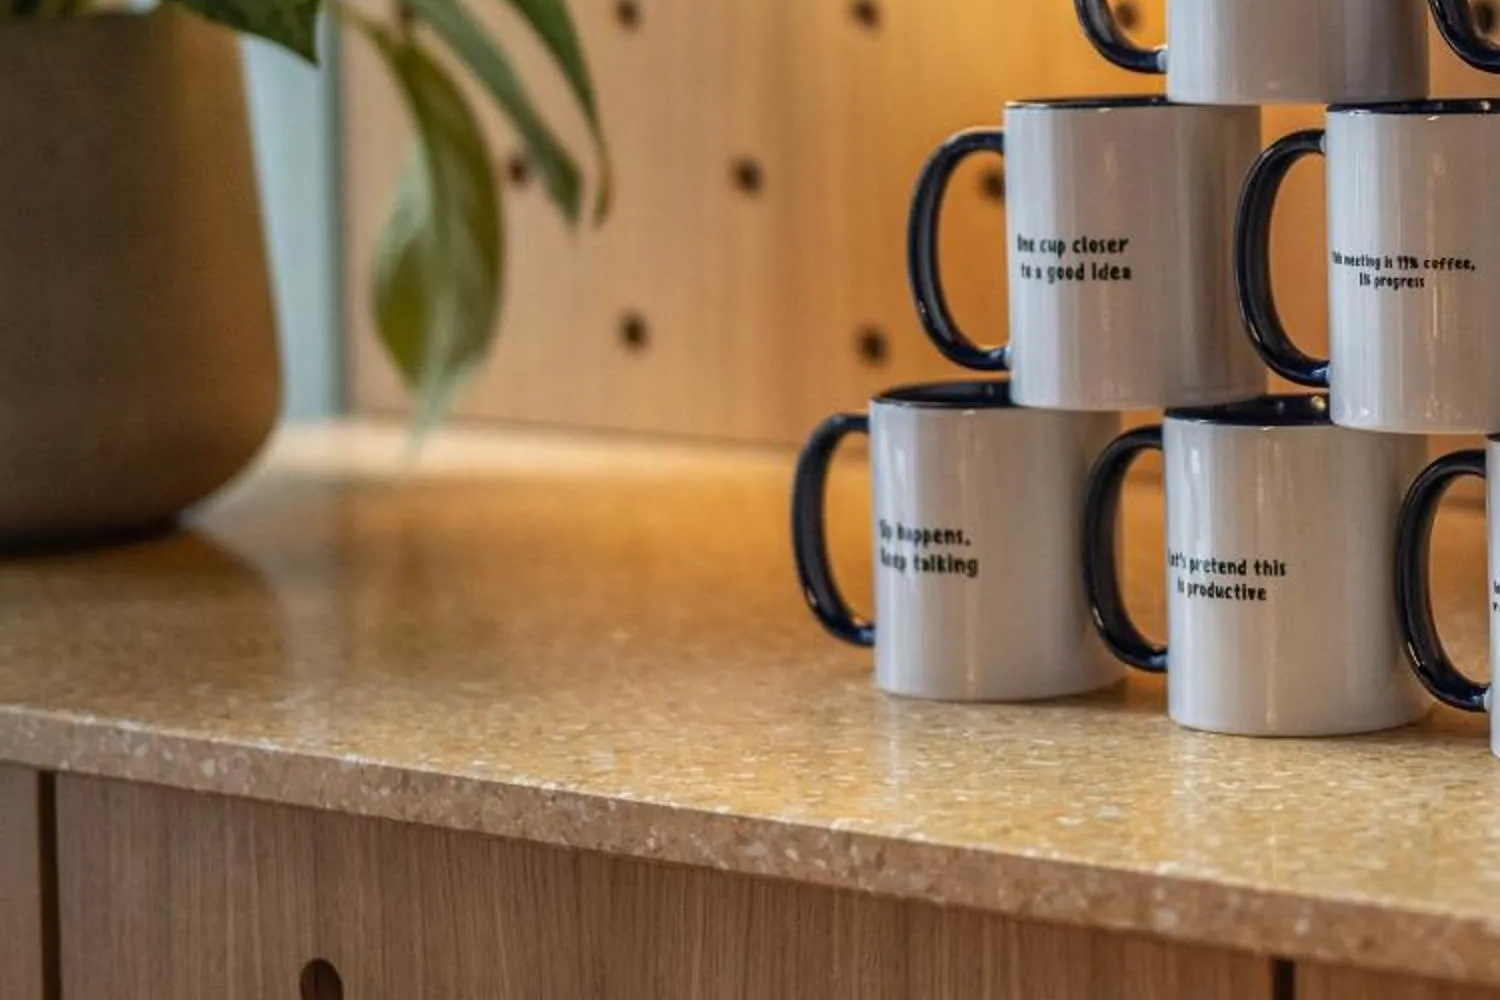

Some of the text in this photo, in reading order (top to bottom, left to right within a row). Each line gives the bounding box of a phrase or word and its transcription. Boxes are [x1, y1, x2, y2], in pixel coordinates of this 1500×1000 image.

[1040, 239, 1066, 259] cup
[1072, 236, 1129, 254] closer
[1344, 254, 1381, 270] meeting
[1424, 256, 1476, 271] coffee,
[1047, 262, 1085, 284] good
[1374, 276, 1425, 290] progress
[913, 553, 979, 578] talking
[1189, 557, 1247, 575] pretend
[1254, 559, 1286, 576] this
[1187, 581, 1267, 601] productive
